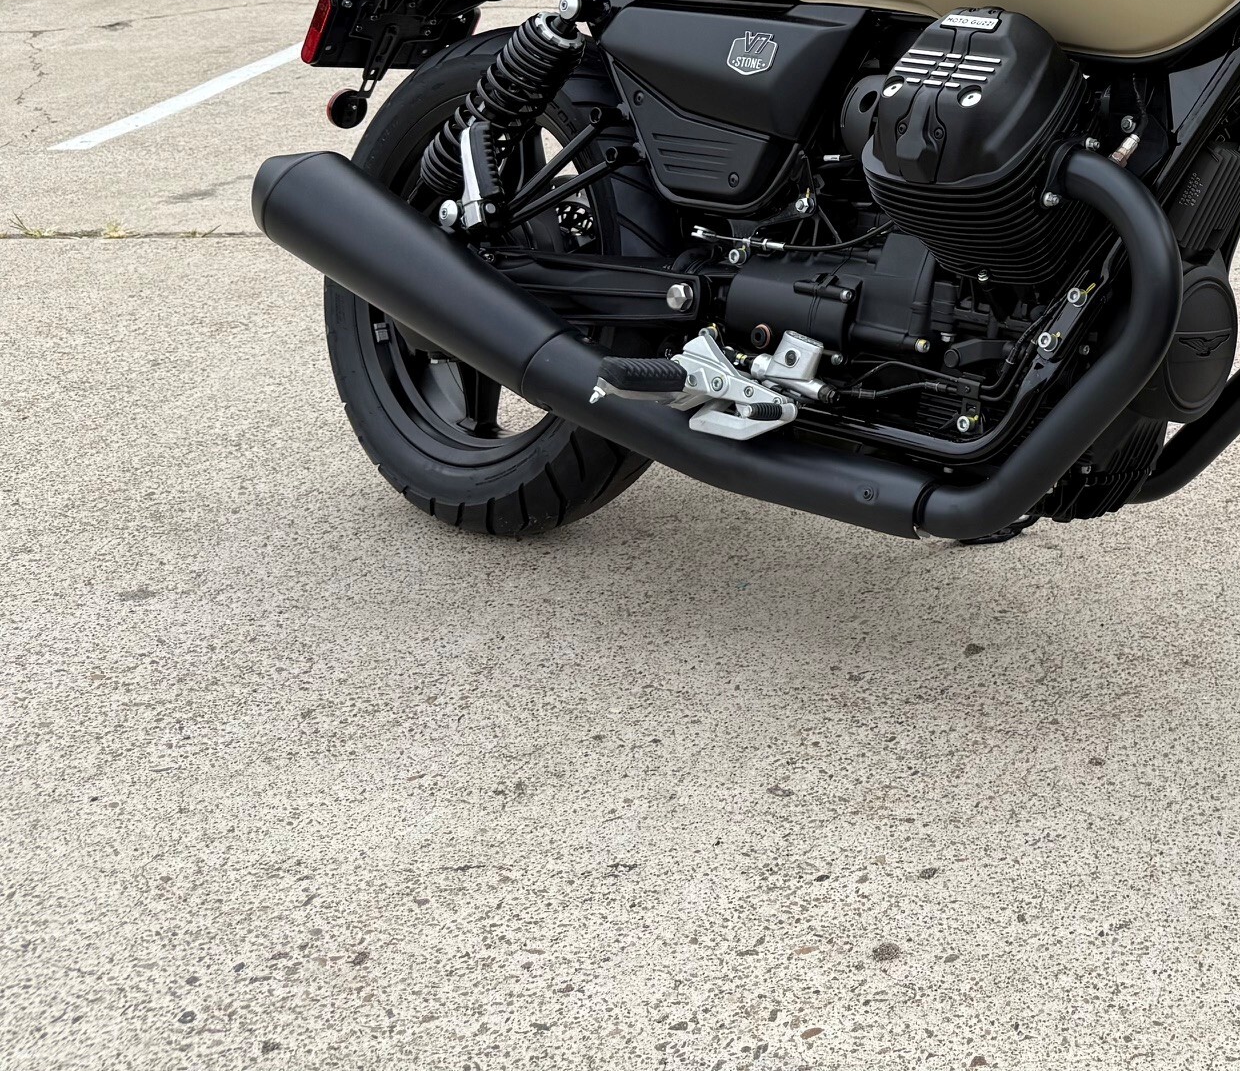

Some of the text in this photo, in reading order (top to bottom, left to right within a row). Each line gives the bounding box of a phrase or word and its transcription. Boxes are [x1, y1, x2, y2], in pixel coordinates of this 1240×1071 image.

[947, 16, 970, 25] MOTO
[744, 30, 775, 54] V7
[734, 56, 763, 70] STONE
